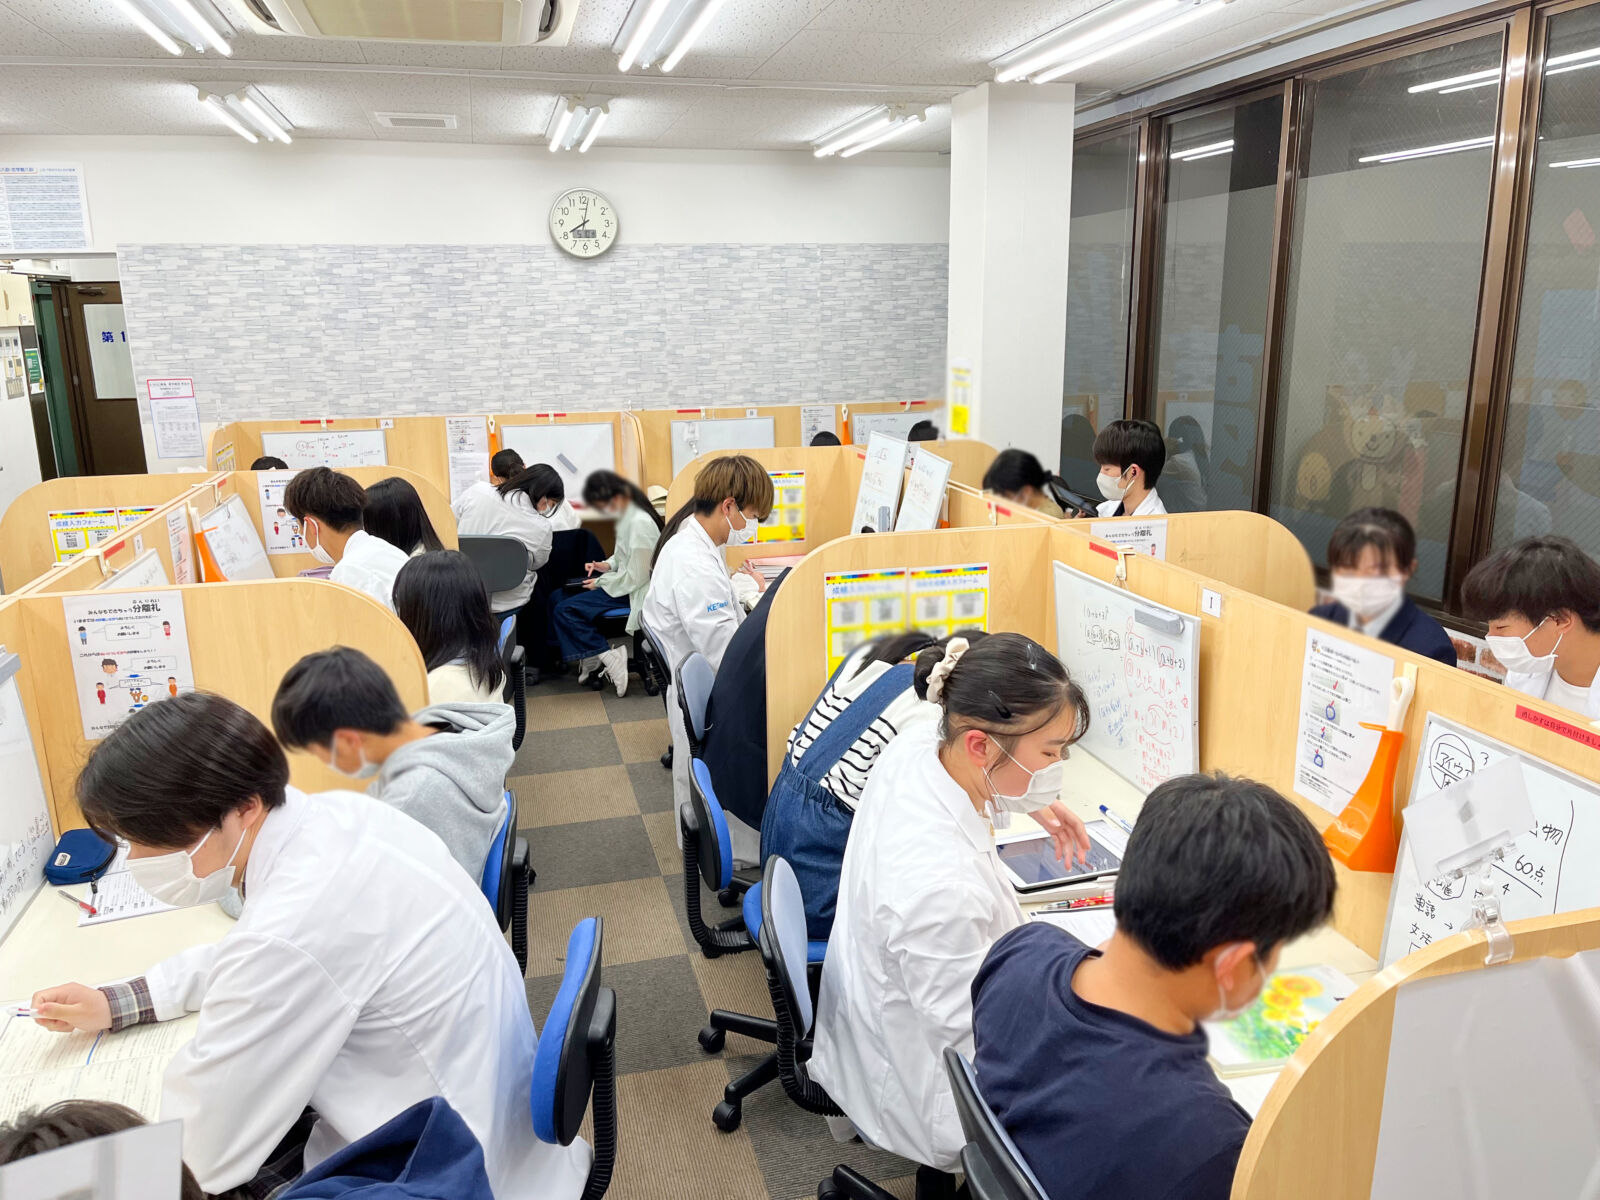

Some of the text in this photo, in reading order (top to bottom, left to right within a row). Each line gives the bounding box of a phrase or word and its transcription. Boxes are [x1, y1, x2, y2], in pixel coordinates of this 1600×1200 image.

[569, 199, 575, 207] 11
[579, 196, 587, 204] 12
[561, 207, 569, 216] 10
[600, 207, 606, 215] 2
[558, 219, 564, 227] 9
[563, 231, 568, 240] 8
[602, 231, 607, 239] 4
[573, 240, 577, 248] 7
